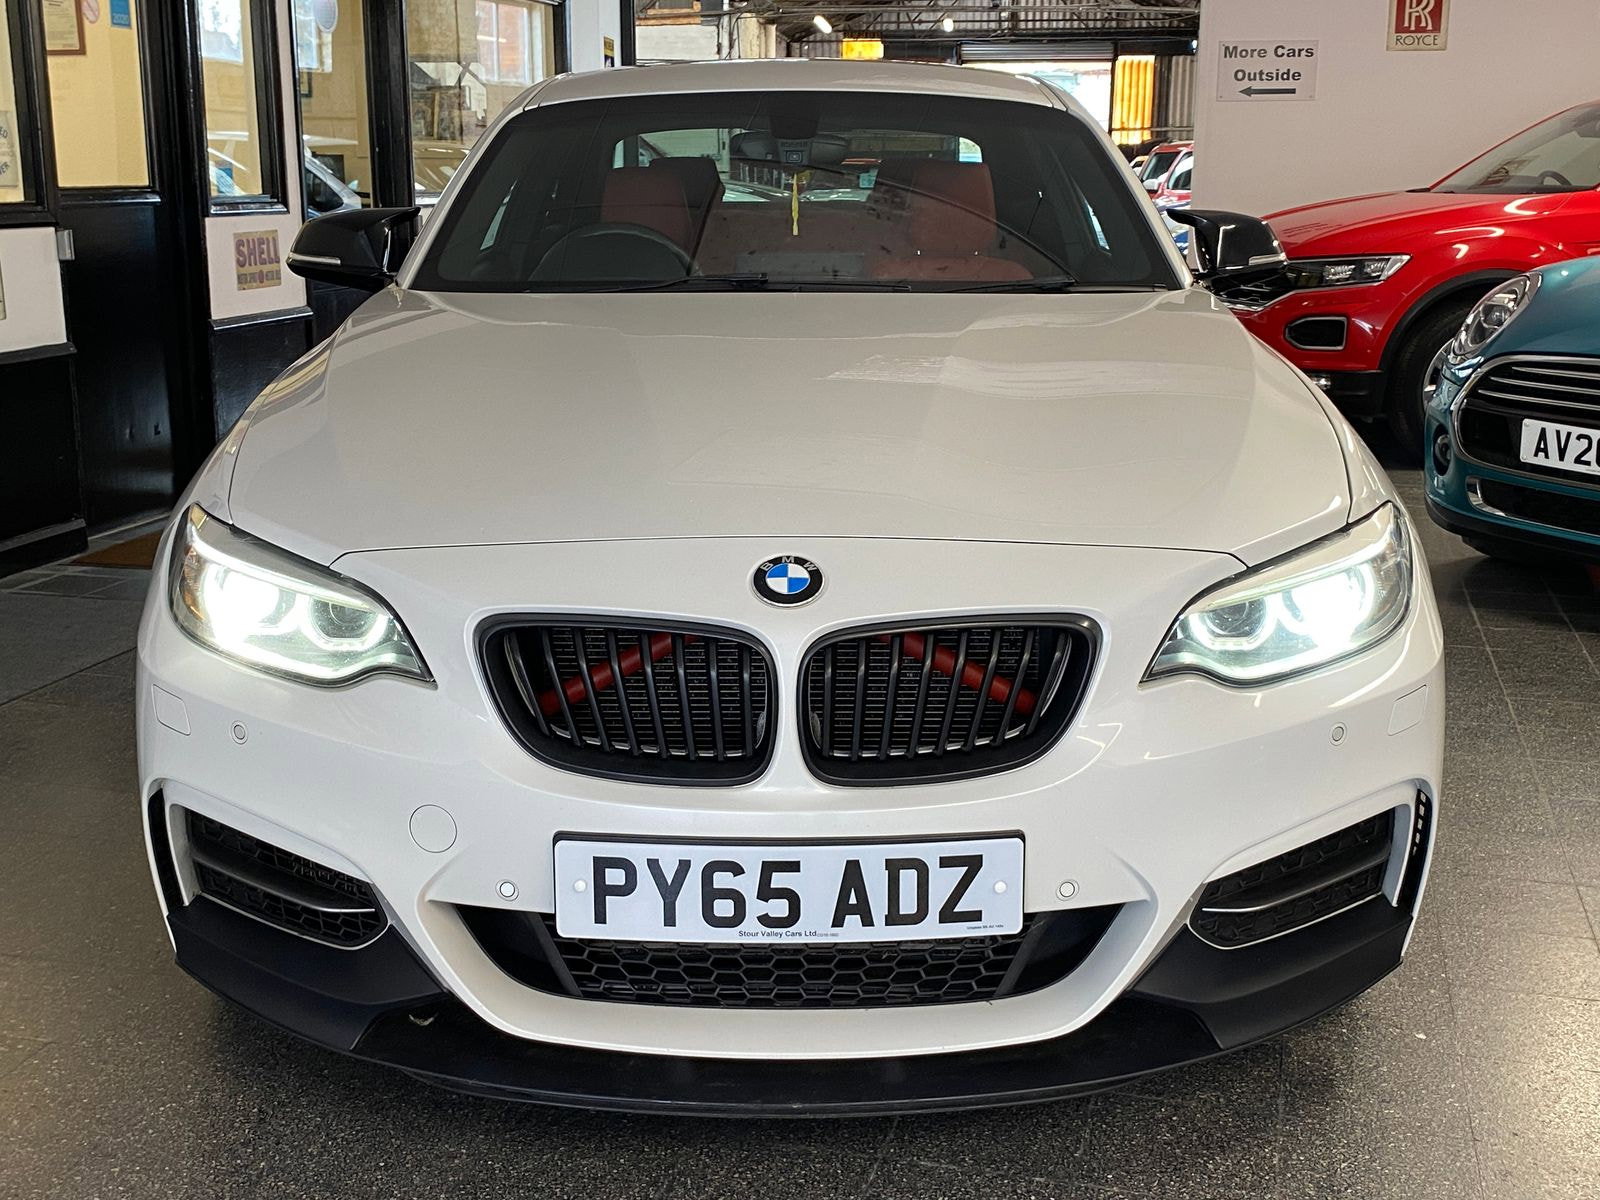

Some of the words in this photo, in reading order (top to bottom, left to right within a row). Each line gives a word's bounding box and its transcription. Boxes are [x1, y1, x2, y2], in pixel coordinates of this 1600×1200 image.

[1395, 35, 1439, 46] ROYCE
[1223, 45, 1268, 58] More
[1273, 44, 1315, 58] Cars
[1233, 68, 1302, 81] Outside
[235, 236, 280, 268] SHELL
[1533, 427, 1600, 467] AV2
[760, 556, 818, 572] BMW
[592, 855, 800, 929] PY65
[831, 853, 984, 929] ADZ
[738, 930, 759, 938] Stour
[760, 930, 784, 939] Valley
[785, 930, 802, 938] Cars
[804, 930, 817, 938] Ltd
